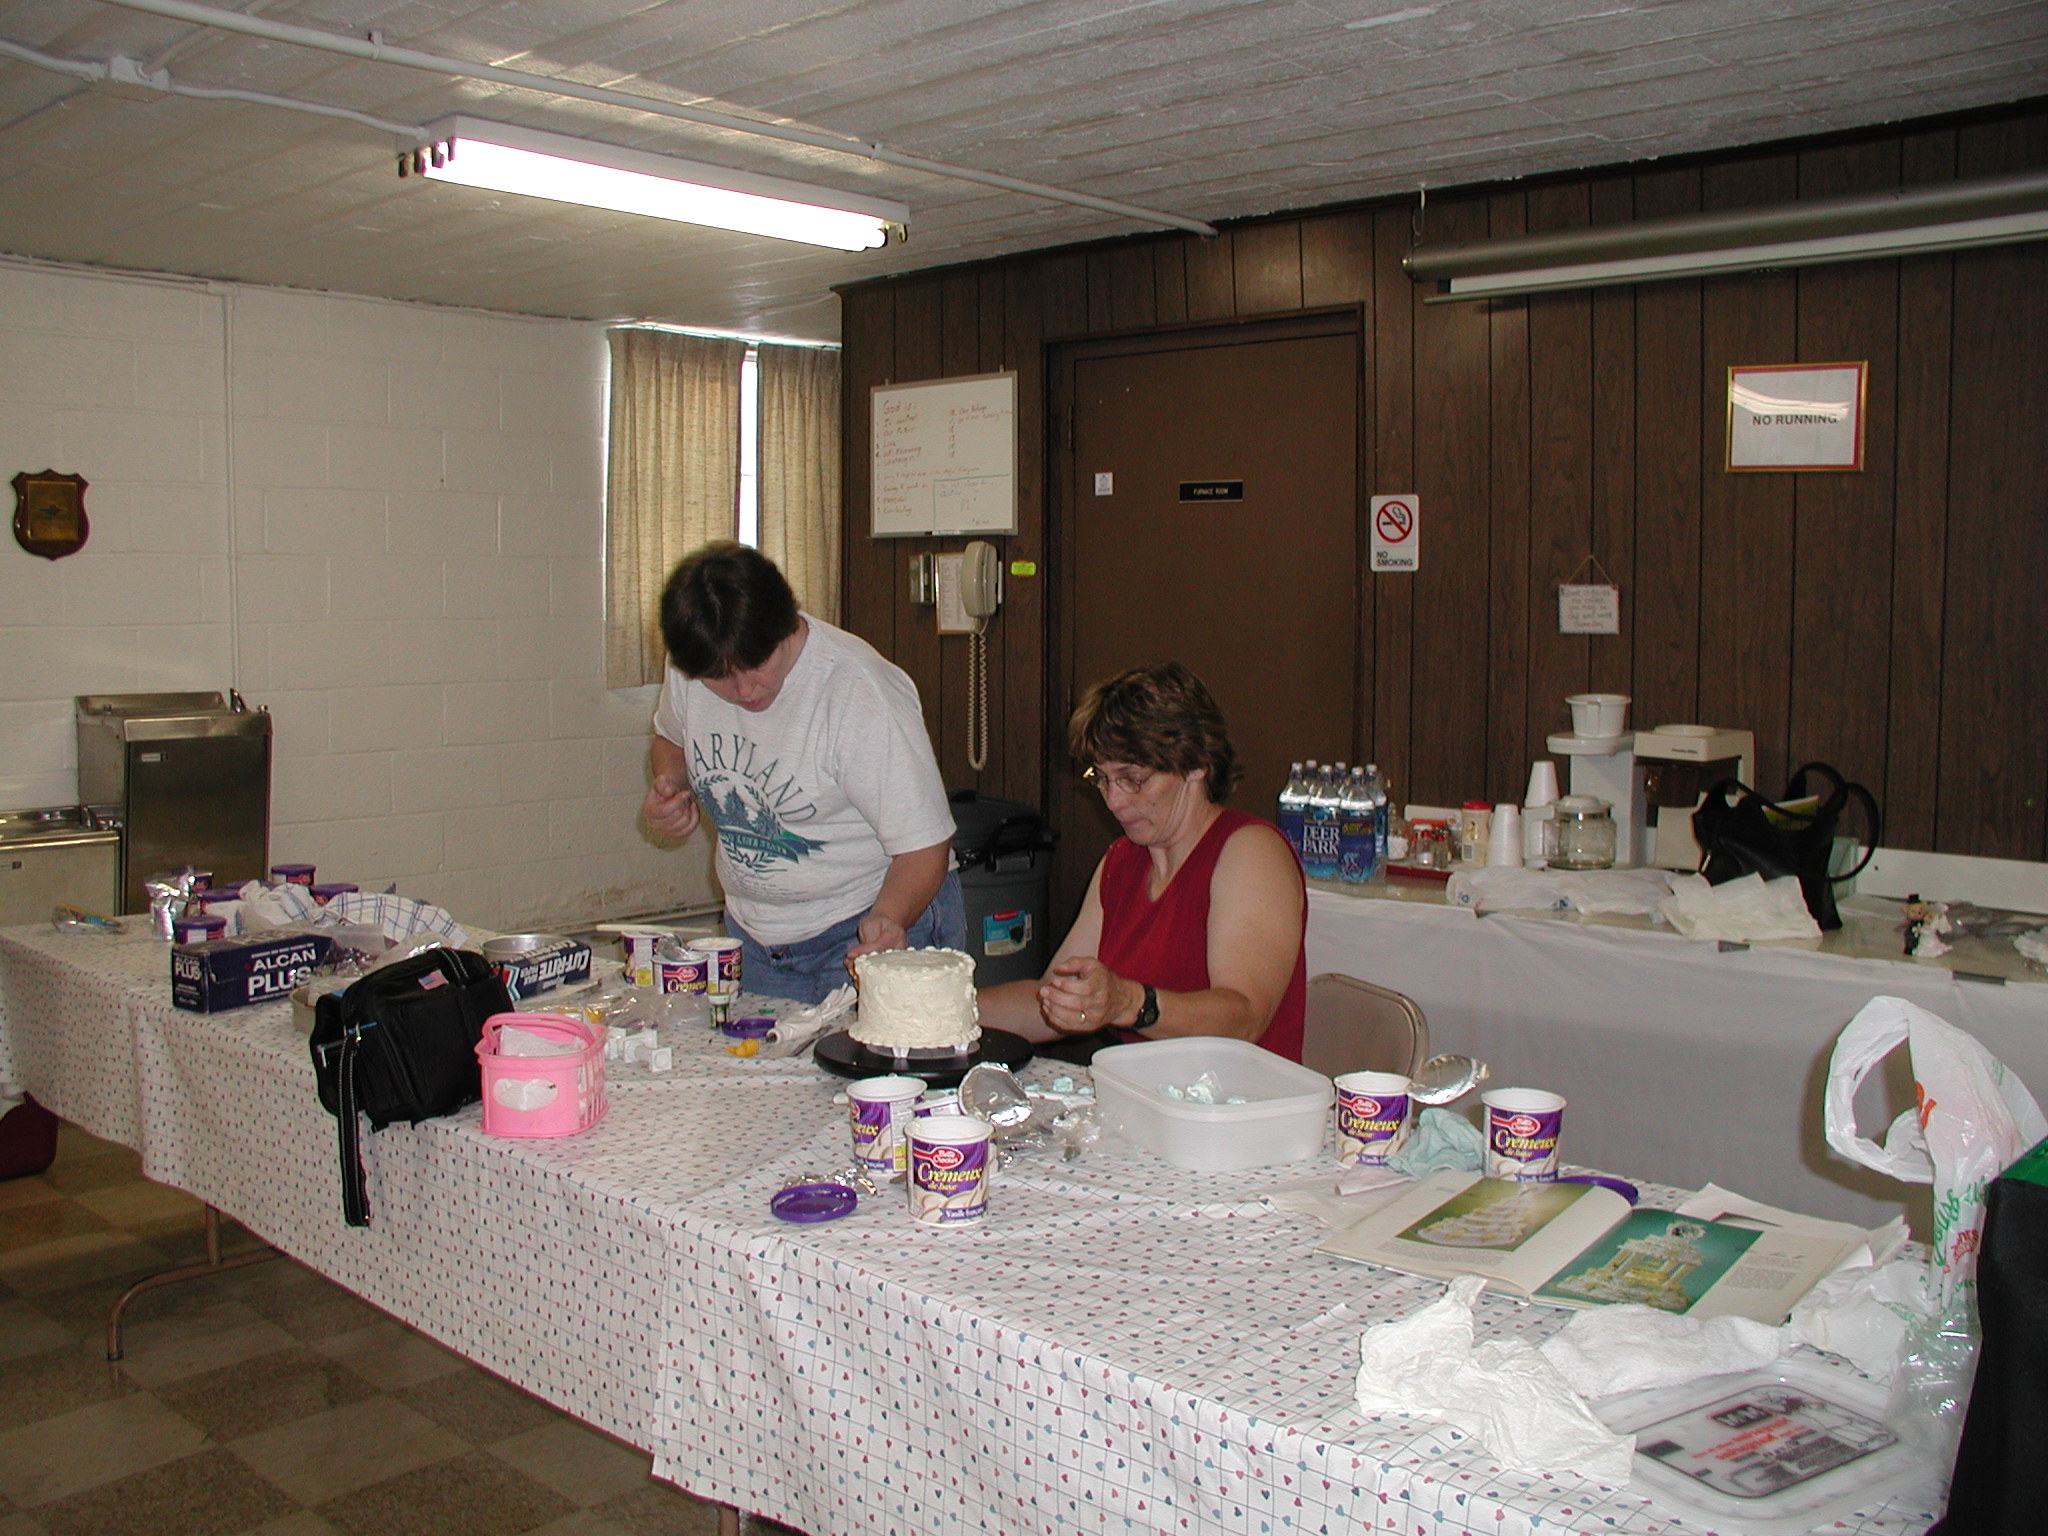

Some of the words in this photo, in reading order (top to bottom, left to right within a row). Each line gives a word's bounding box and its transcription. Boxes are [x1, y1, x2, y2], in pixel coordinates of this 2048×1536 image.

[1752, 415, 1772, 426] NO
[1775, 413, 1838, 425] RUNNING
[689, 733, 817, 823] ARYLAND
[1304, 825, 1340, 841] DEER
[1303, 839, 1339, 855] PARK
[253, 949, 317, 972] ALCAN
[175, 962, 202, 980] PLUS
[248, 966, 311, 996] PLUS
